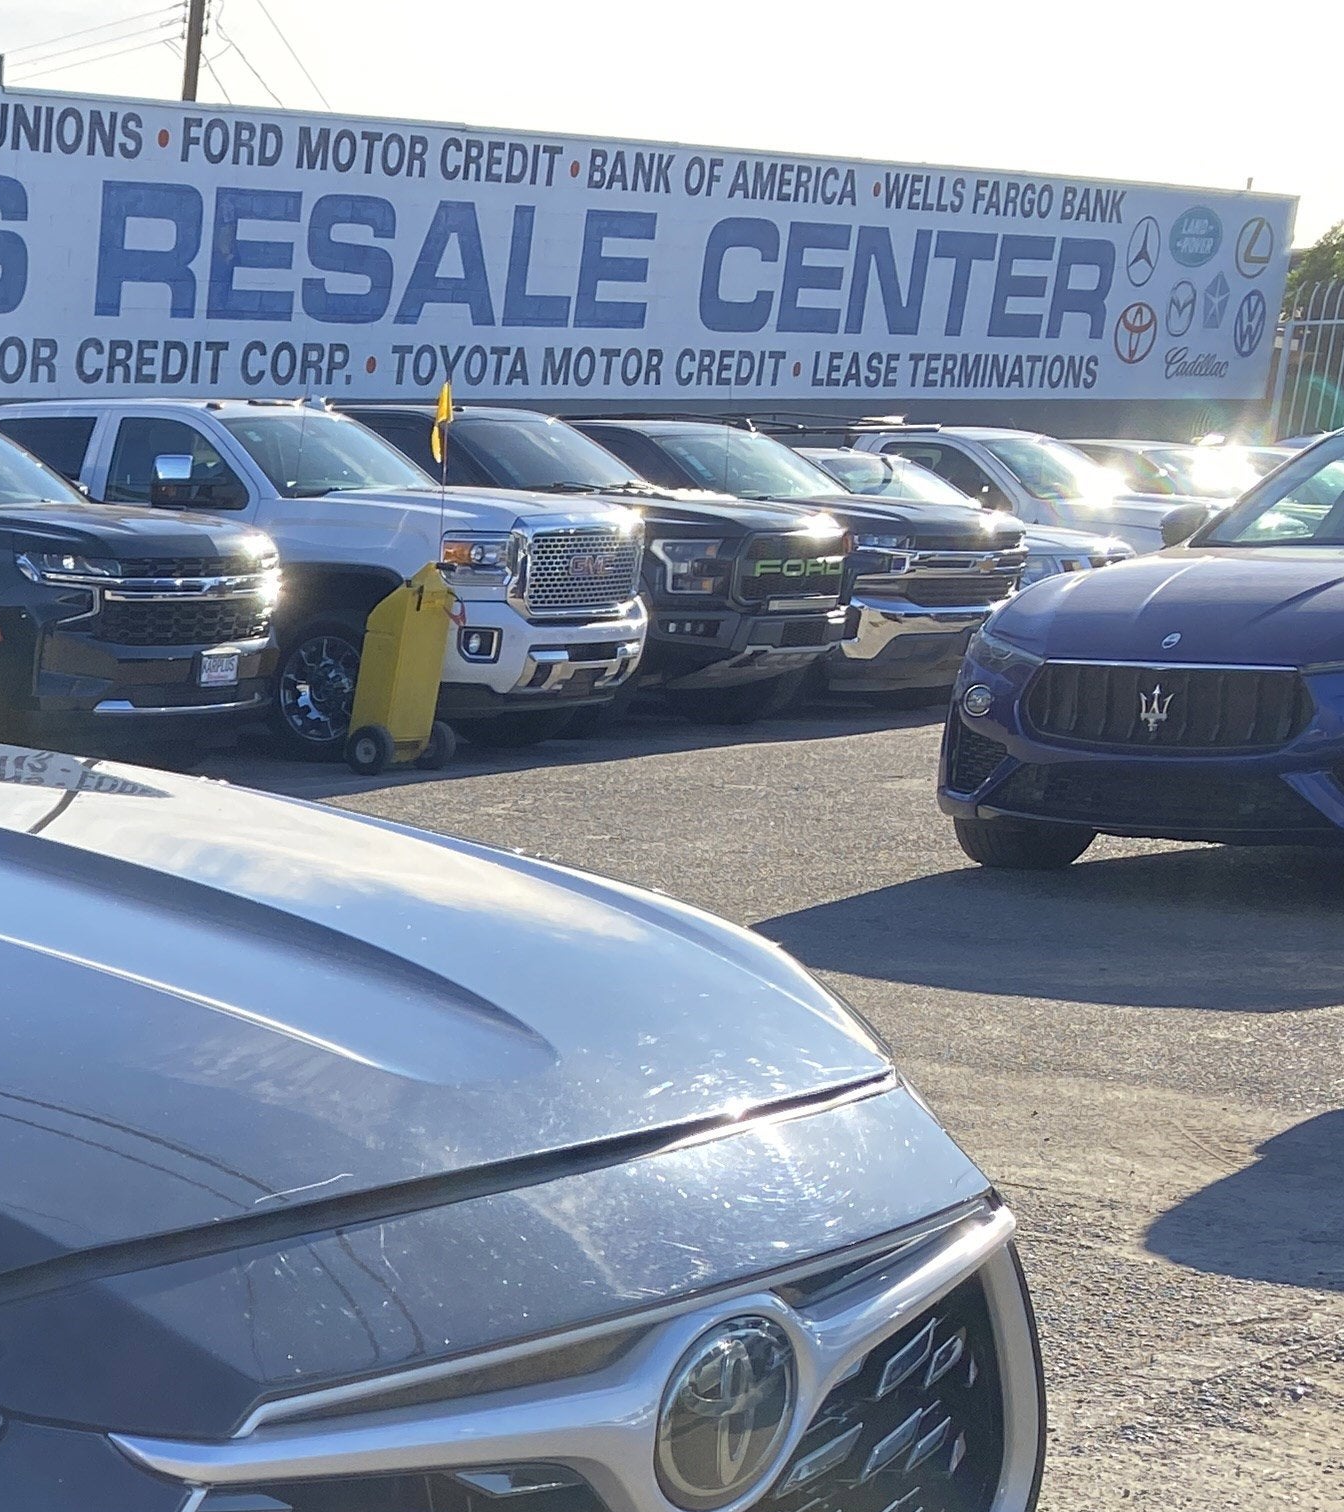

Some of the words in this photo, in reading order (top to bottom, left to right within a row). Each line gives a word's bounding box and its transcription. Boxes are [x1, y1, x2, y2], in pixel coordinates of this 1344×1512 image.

[180, 117, 283, 167] FORD
[296, 128, 427, 179] MOTOR
[439, 137, 564, 187] CREDIT
[586, 148, 676, 195] BANK
[684, 156, 724, 197] OF
[727, 160, 858, 206] AMERICA
[884, 171, 966, 213] WELLS
[971, 179, 1054, 219] FARGO
[1059, 186, 1127, 224] BANK
[93, 179, 658, 330] RESALE
[698, 216, 1116, 340] CENTER
[75, 337, 230, 385] CREDIT
[240, 340, 353, 386] CORP.
[391, 343, 529, 387] TOYOTA
[541, 346, 664, 387] MOTOR
[674, 348, 787, 387] CREDIT
[811, 350, 901, 388] LEASE
[907, 352, 1100, 390] TERMINATIONS
[1164, 346, 1230, 380] Cadillac
[754, 557, 843, 578] FORD
